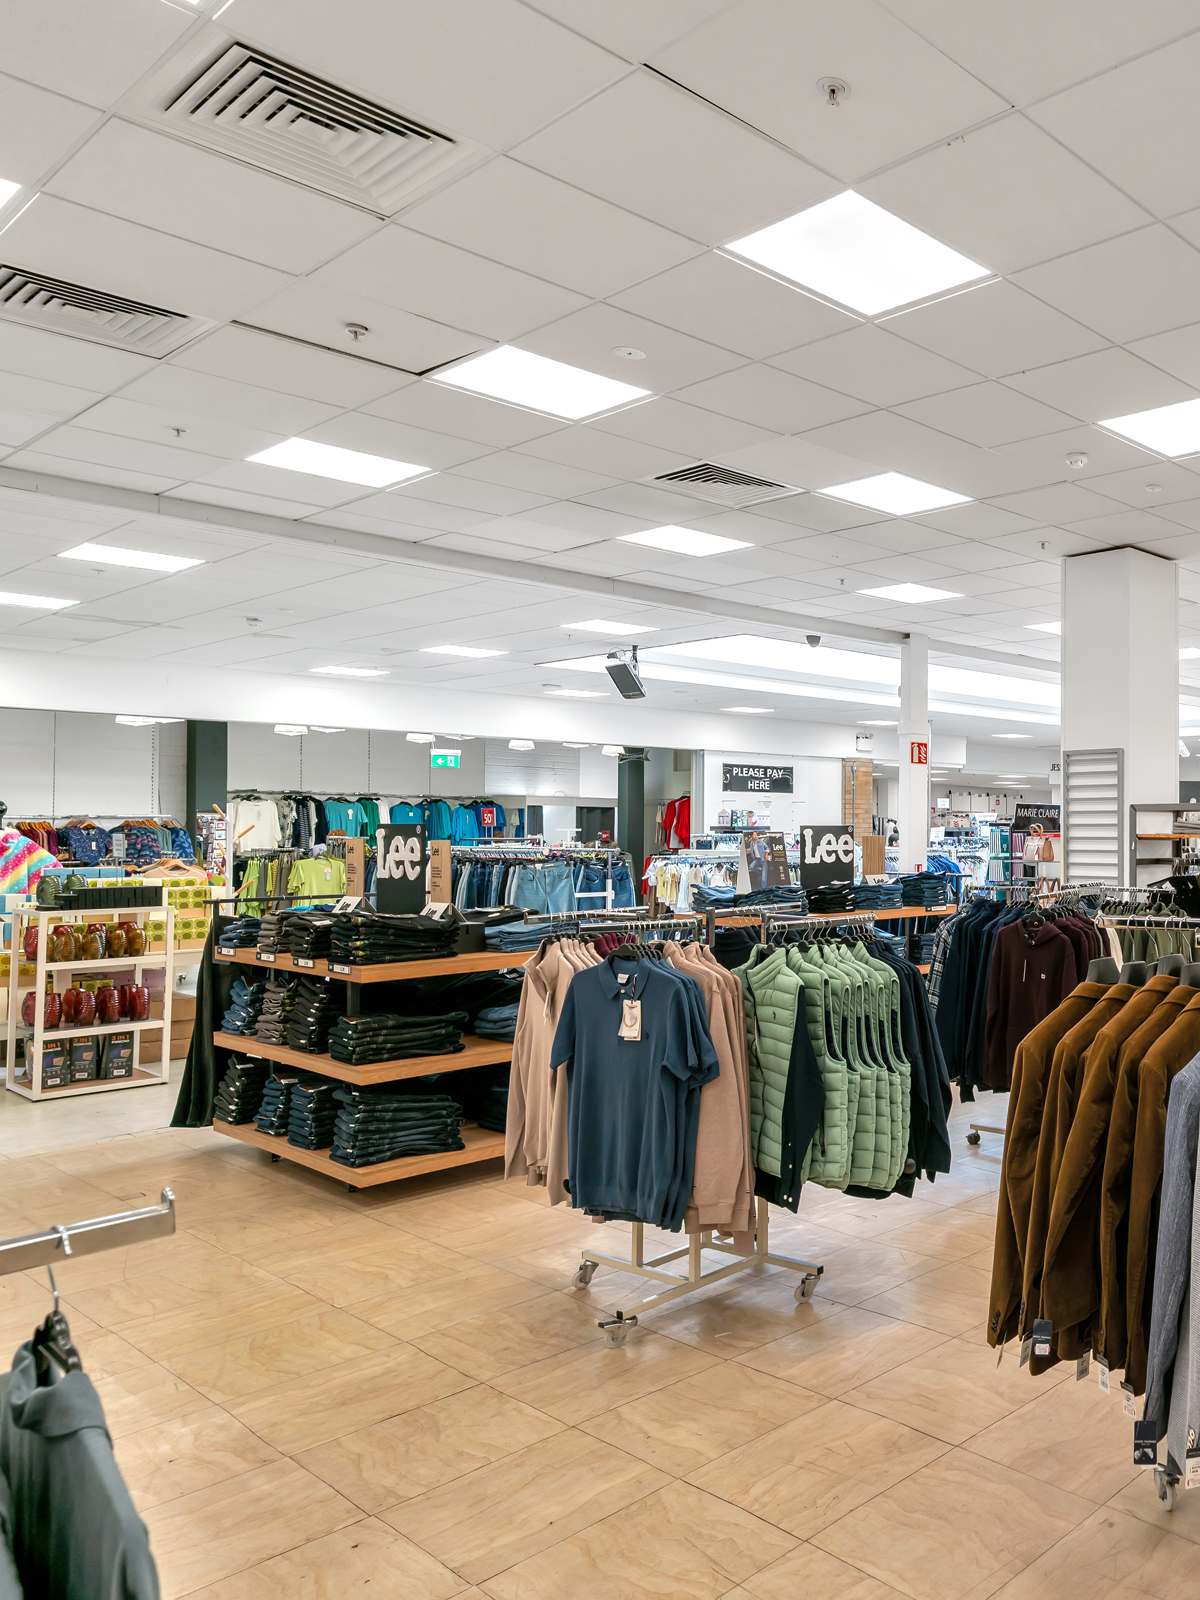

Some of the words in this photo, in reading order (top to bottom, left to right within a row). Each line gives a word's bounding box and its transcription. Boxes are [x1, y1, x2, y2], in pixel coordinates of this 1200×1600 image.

[733, 767, 764, 777] PLEASE
[767, 769, 783, 778] PAY
[748, 781, 770, 790] HERE
[1017, 808, 1037, 817] MARIE
[1038, 808, 1059, 818] CLAIRE
[432, 846, 440, 856] Lee
[772, 843, 784, 851] Lee
[802, 828, 854, 864] Lee
[375, 828, 421, 881] Lee
[339, 902, 351, 911] Lee
